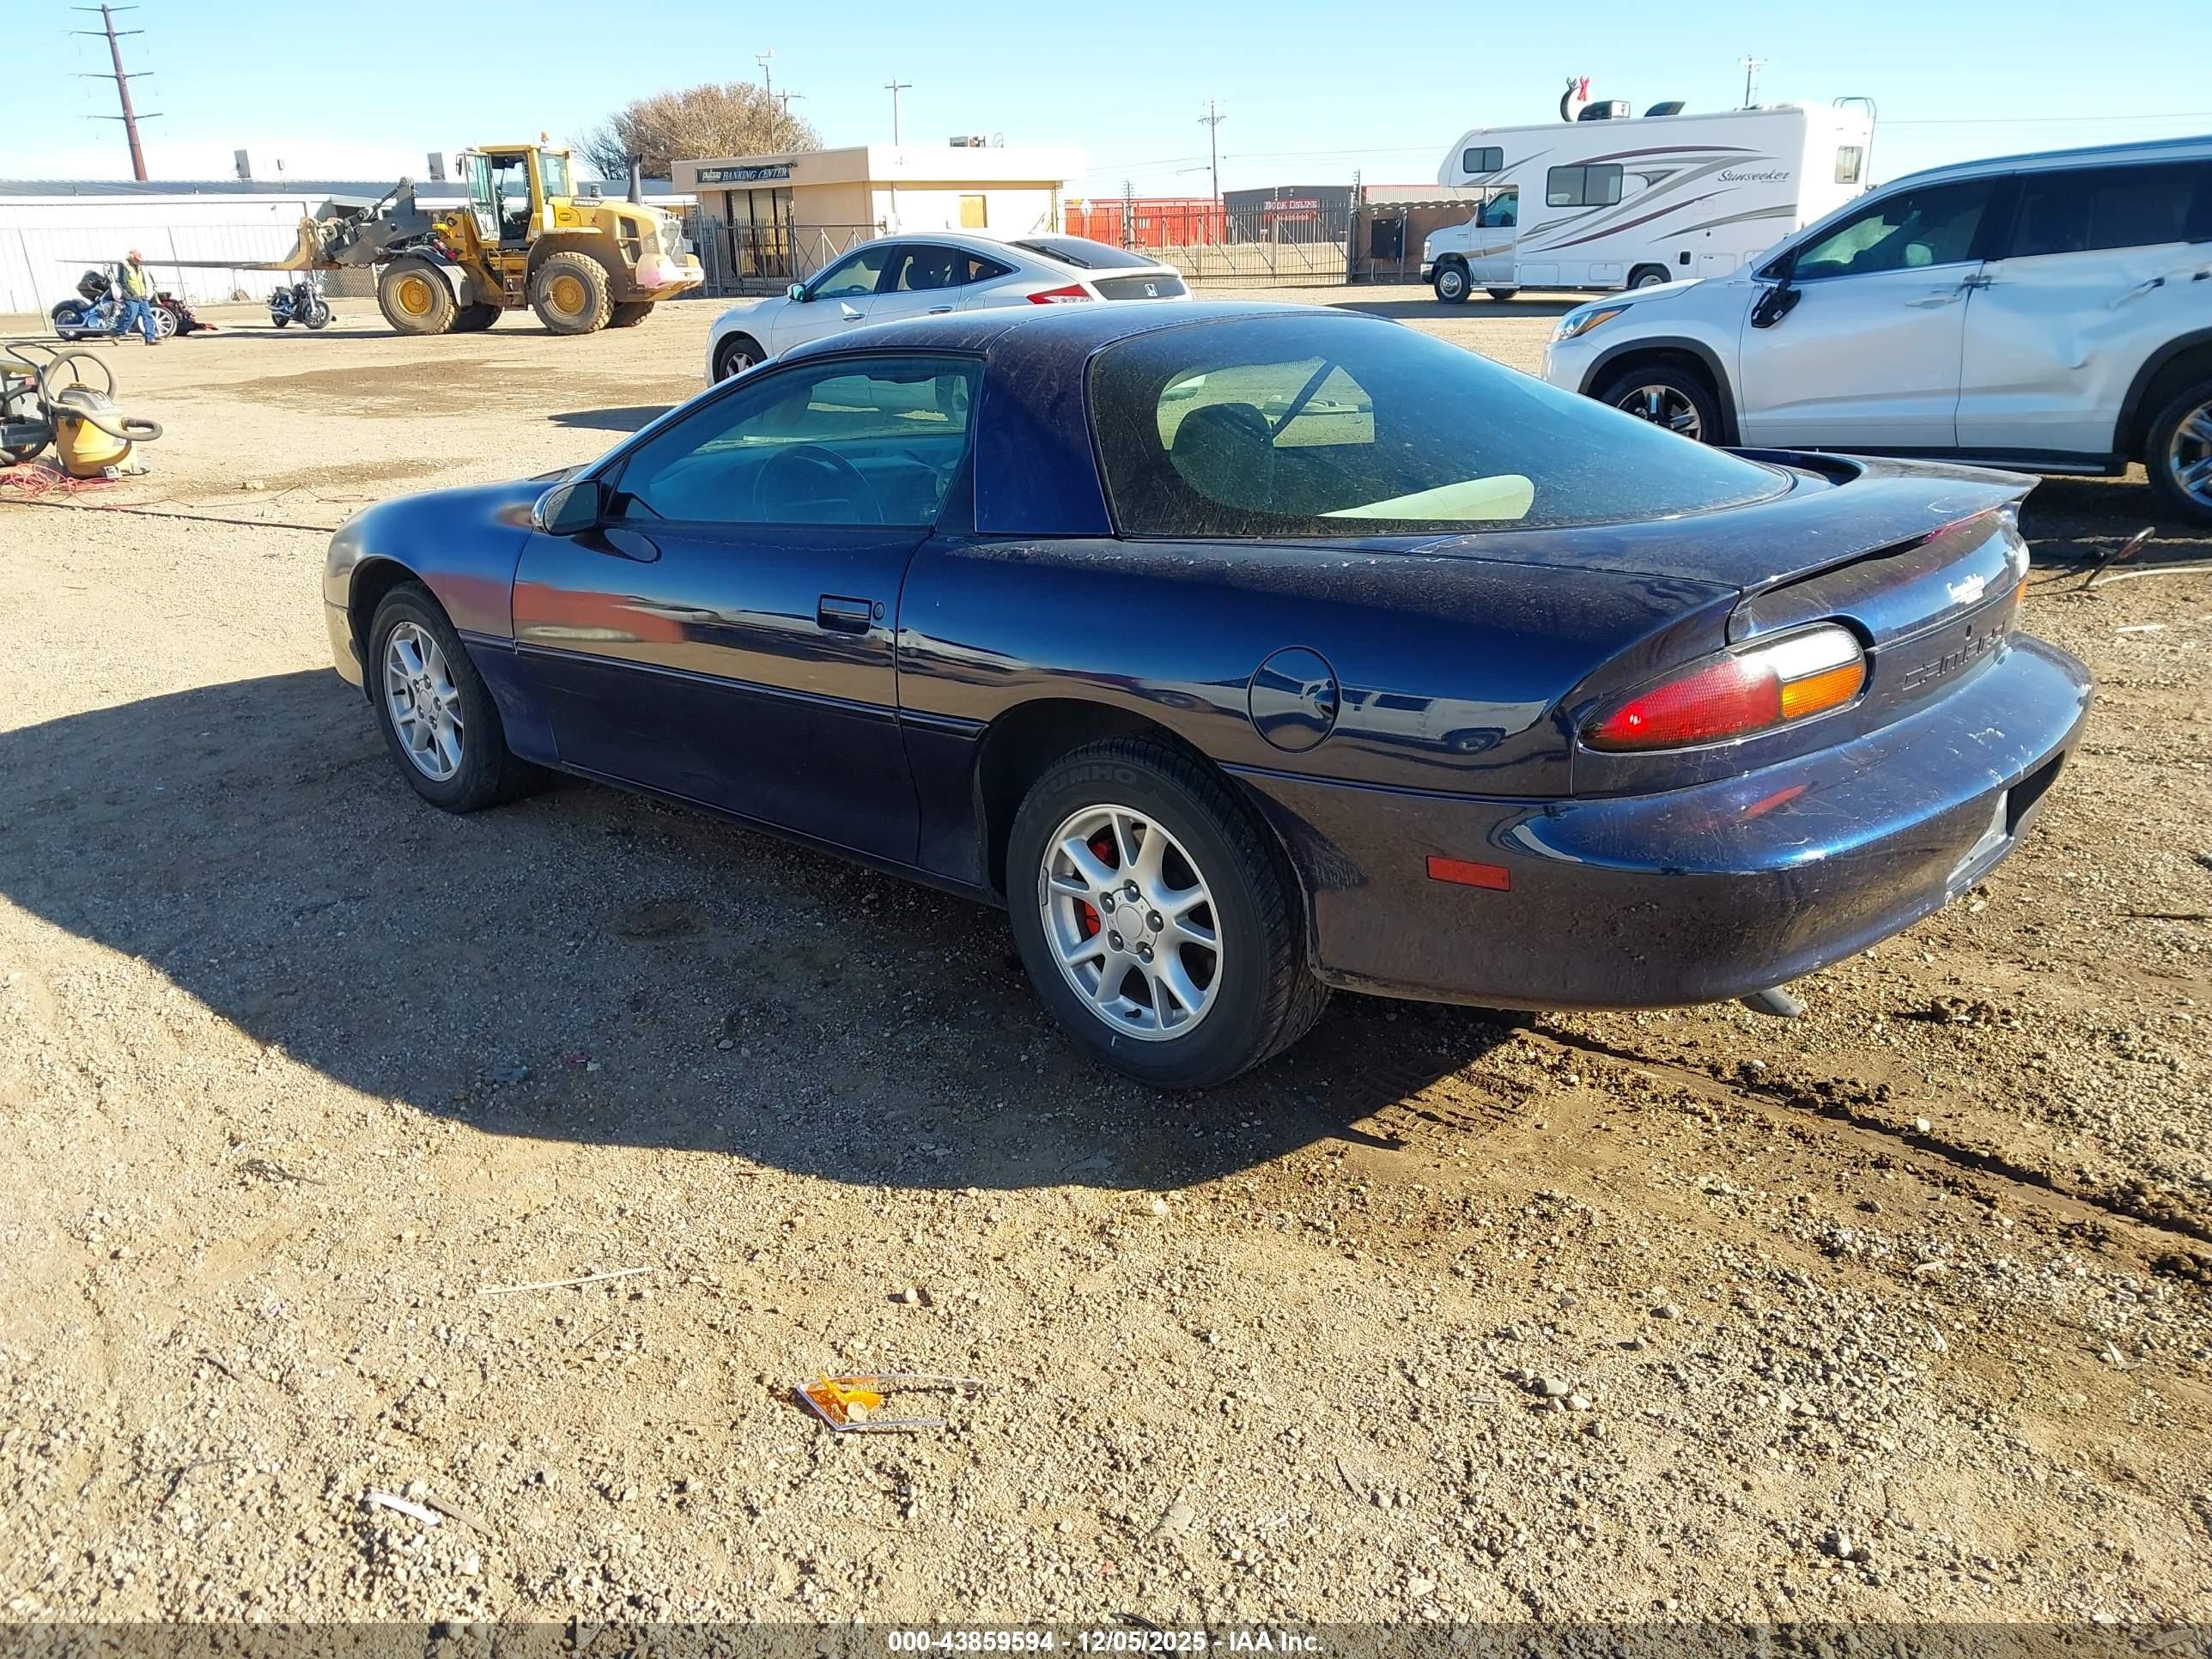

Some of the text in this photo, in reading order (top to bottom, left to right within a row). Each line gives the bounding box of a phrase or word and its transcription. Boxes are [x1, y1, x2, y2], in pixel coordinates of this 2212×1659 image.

[722, 170, 756, 181] BANKING
[757, 167, 787, 179] CENTER
[1717, 169, 1790, 182] Sunseeker
